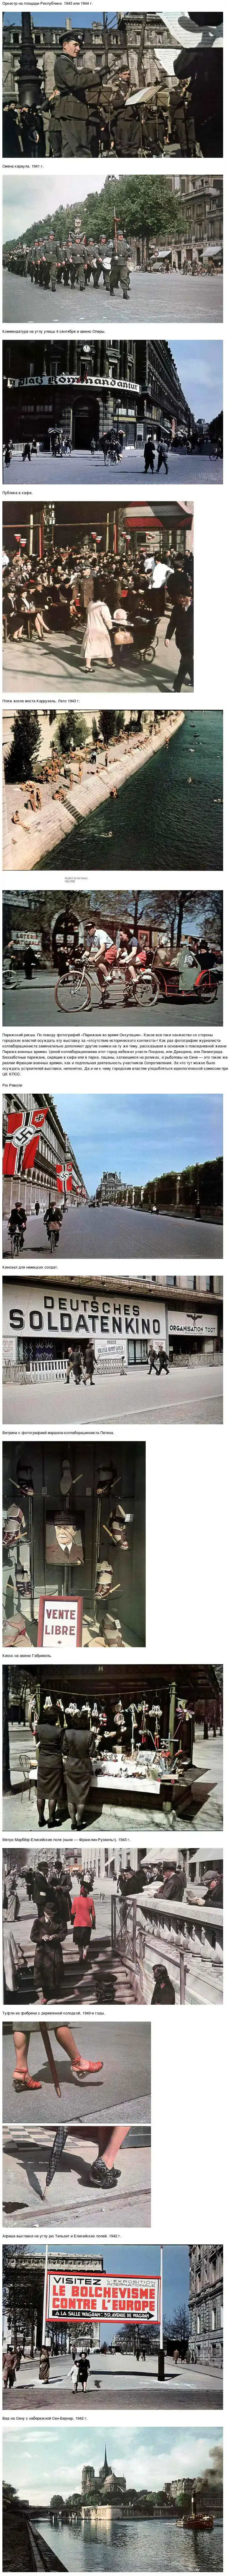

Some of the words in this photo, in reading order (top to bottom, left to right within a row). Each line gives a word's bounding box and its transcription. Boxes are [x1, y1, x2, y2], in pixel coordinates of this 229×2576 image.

[44, 1296, 140, 1316] DEUTSCHES
[9, 1309, 160, 1335] SOLDATENKINO
[46, 1609, 76, 1620] VENTE
[45, 1625, 75, 1635] LIBRE
[52, 2285, 65, 2296] LE
[72, 2286, 155, 2299] BOLCHEVISME
[52, 2298, 97, 2310] CONTRE
[102, 2299, 155, 2311] L'EUROPE
